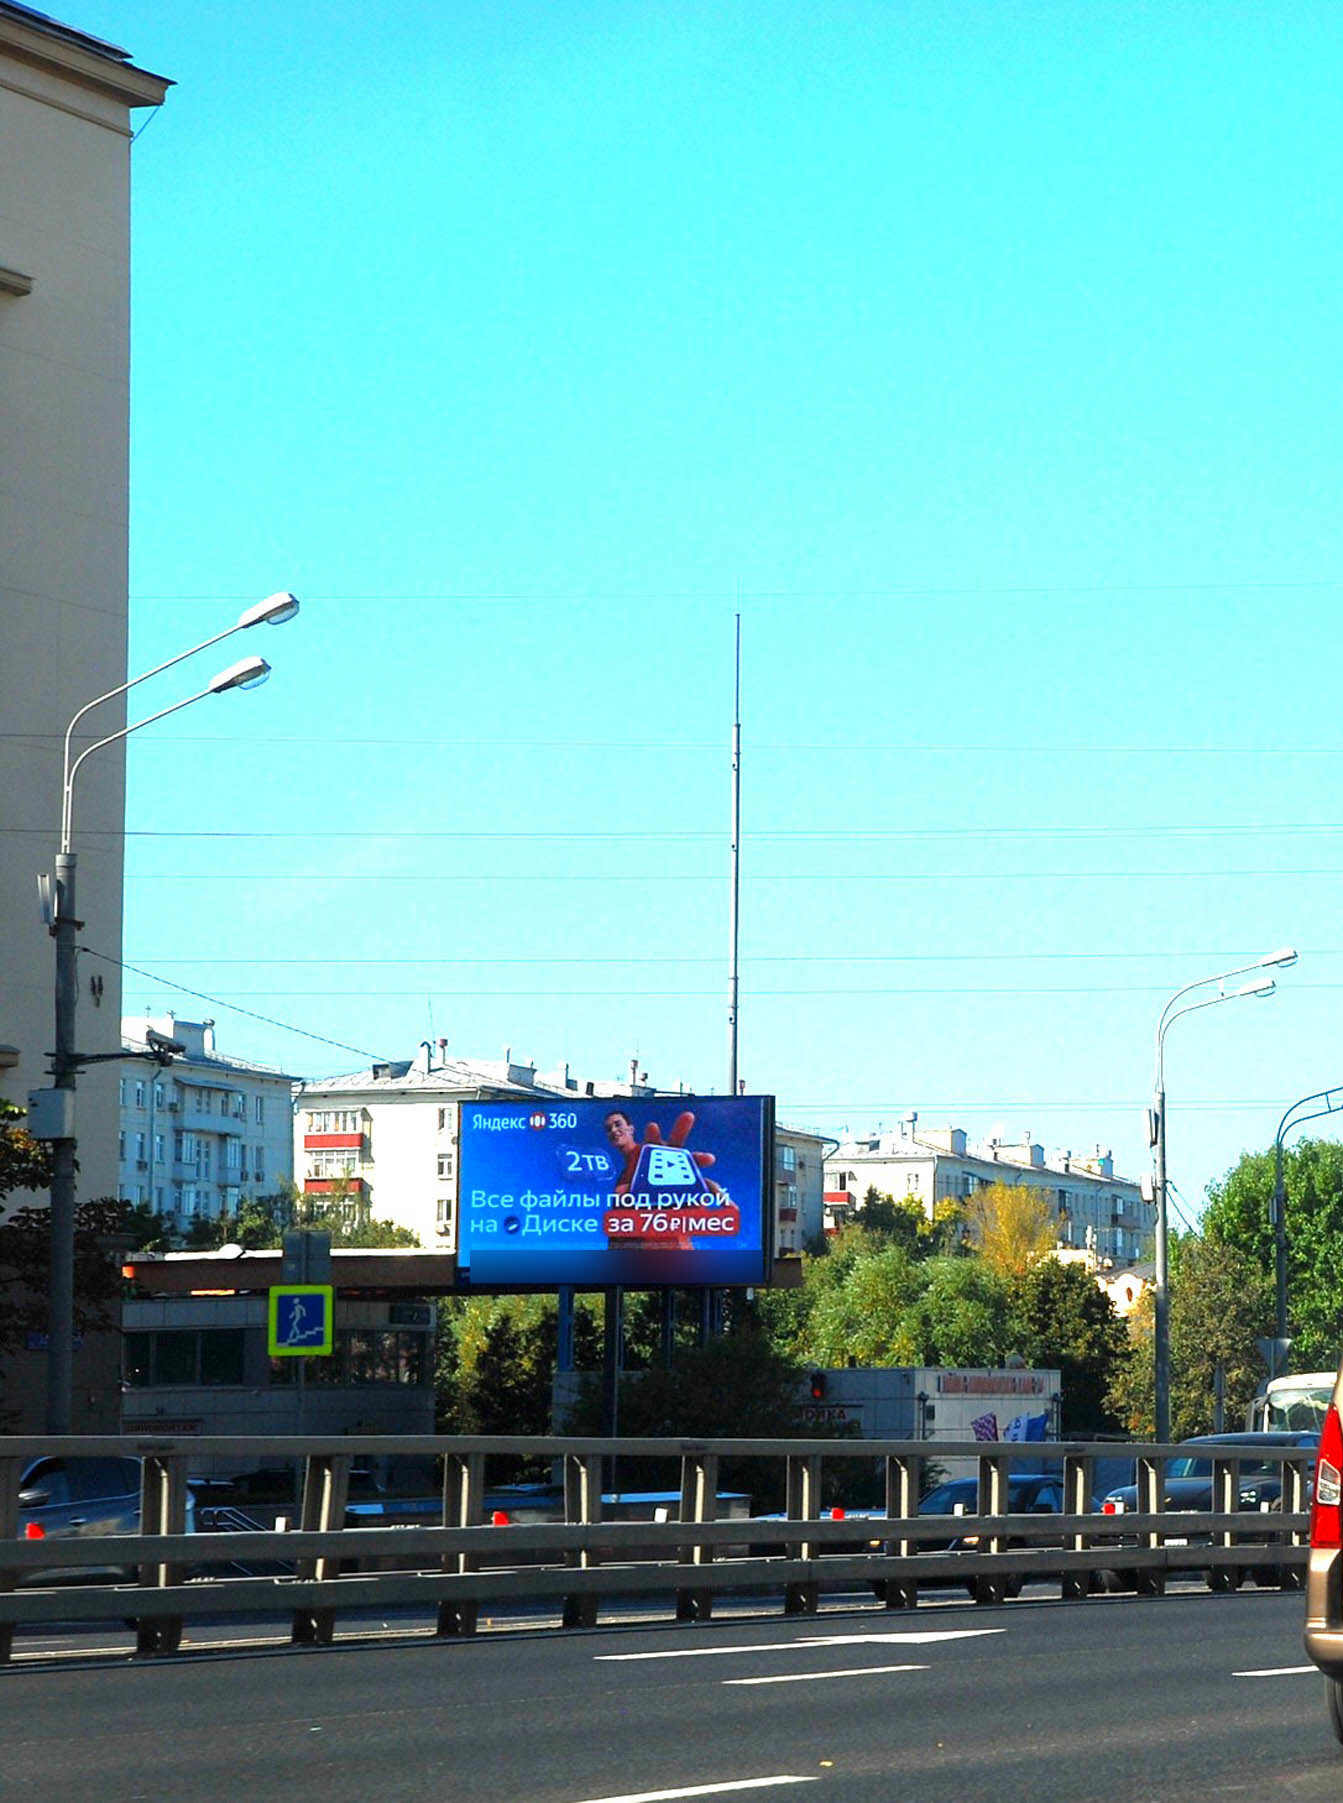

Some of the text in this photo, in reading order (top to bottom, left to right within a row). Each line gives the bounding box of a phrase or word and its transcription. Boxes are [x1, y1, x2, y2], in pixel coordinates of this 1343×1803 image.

[472, 1112, 577, 1131] Яндекс 360
[471, 1187, 730, 1212] Все файлы под рукой
[470, 1218, 498, 1233] на
[521, 1213, 598, 1236] Диске
[607, 1217, 634, 1232] за
